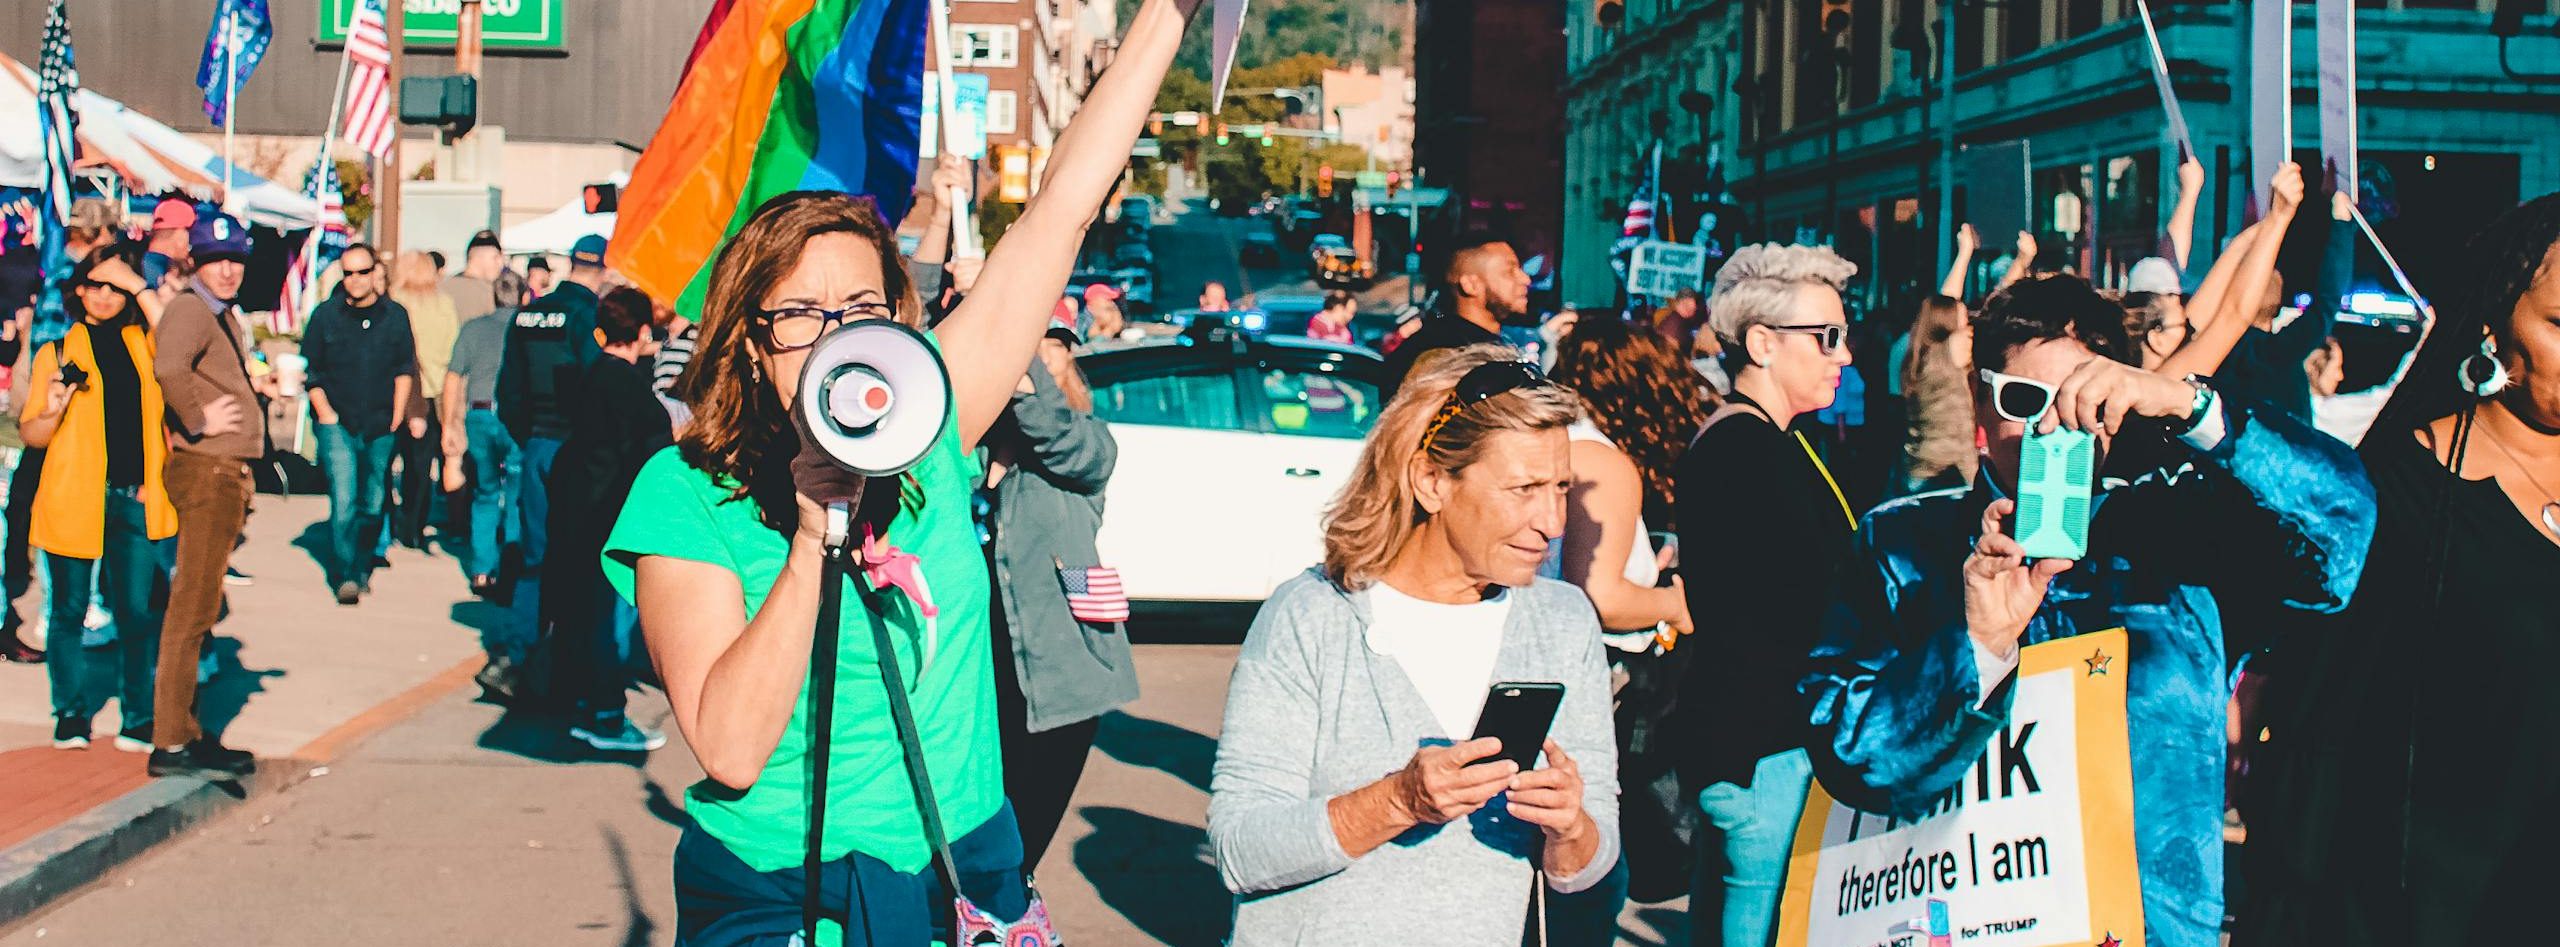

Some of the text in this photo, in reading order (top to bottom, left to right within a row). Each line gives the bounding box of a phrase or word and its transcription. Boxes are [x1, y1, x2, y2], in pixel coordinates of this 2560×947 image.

[1837, 833, 2049, 917] therefore I am
[1961, 926, 1981, 939] for
[1985, 917, 2038, 936] TRUMP
